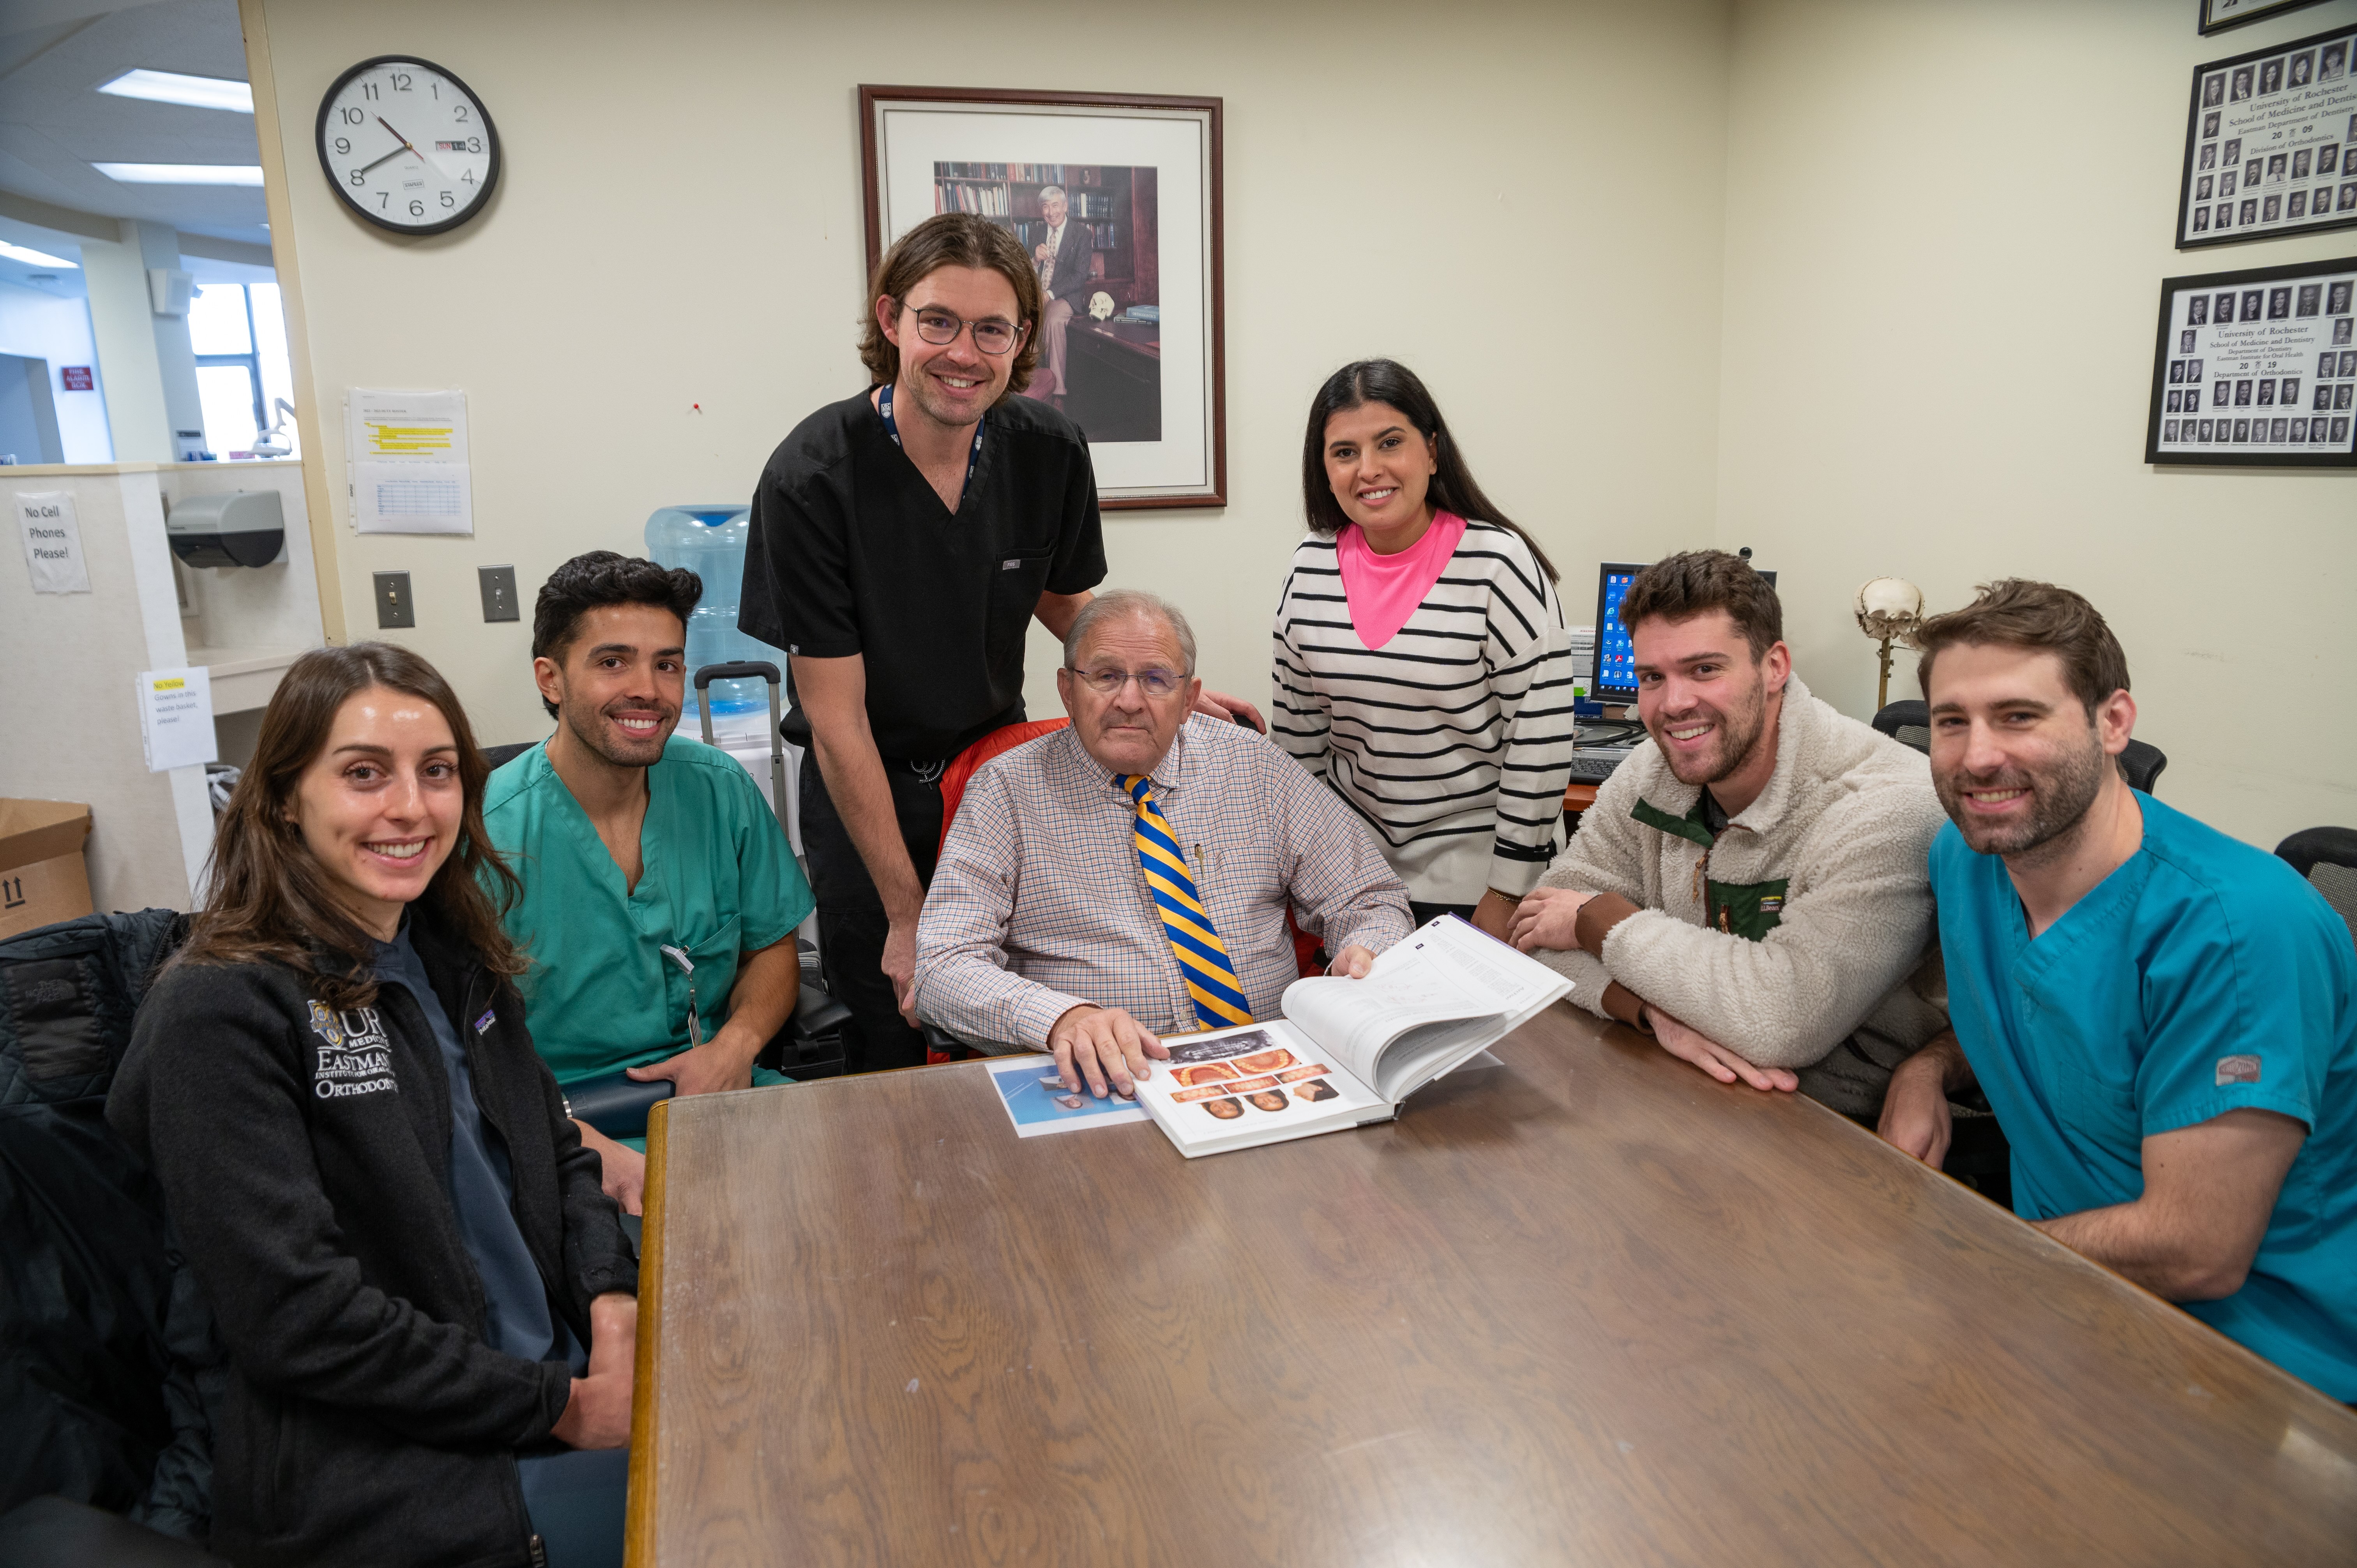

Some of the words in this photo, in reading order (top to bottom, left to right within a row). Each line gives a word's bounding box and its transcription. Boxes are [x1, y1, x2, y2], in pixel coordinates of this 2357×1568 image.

[390, 73, 412, 91] 12
[431, 82, 438, 99] 1
[362, 83, 379, 100] 11
[2250, 97, 2290, 112] University
[2292, 93, 2301, 102] of
[2305, 84, 2349, 99] Rochester
[340, 107, 364, 124] 10
[454, 106, 468, 122] 2
[2229, 115, 2255, 127] School
[2256, 112, 2265, 121] of
[2268, 106, 2306, 118] Medicine
[2308, 99, 2325, 110] and
[2238, 125, 2265, 135] Eastman
[2268, 115, 2308, 129] Department
[2321, 106, 2355, 118] Dentistry
[2272, 131, 2283, 140] 20
[2302, 125, 2313, 133] 09
[335, 137, 350, 154] 9
[467, 137, 481, 153] 3
[2250, 143, 2277, 155] Division
[2288, 133, 2334, 147] Orthodontics
[350, 169, 365, 186] 8
[461, 168, 475, 185] 4
[376, 191, 389, 208] 7
[440, 191, 454, 207] 5
[409, 200, 424, 216] 6
[2219, 330, 2255, 338] University
[2269, 326, 2309, 335] Rochester
[2284, 336, 2315, 344] Dentistry
[25, 507, 39, 517] No
[41, 505, 59, 517] Cell
[29, 527, 65, 538] Phones
[34, 547, 68, 558] Please!
[176, 702, 198, 710] basket,
[157, 715, 179, 726] please!
[339, 1007, 387, 1037] UR
